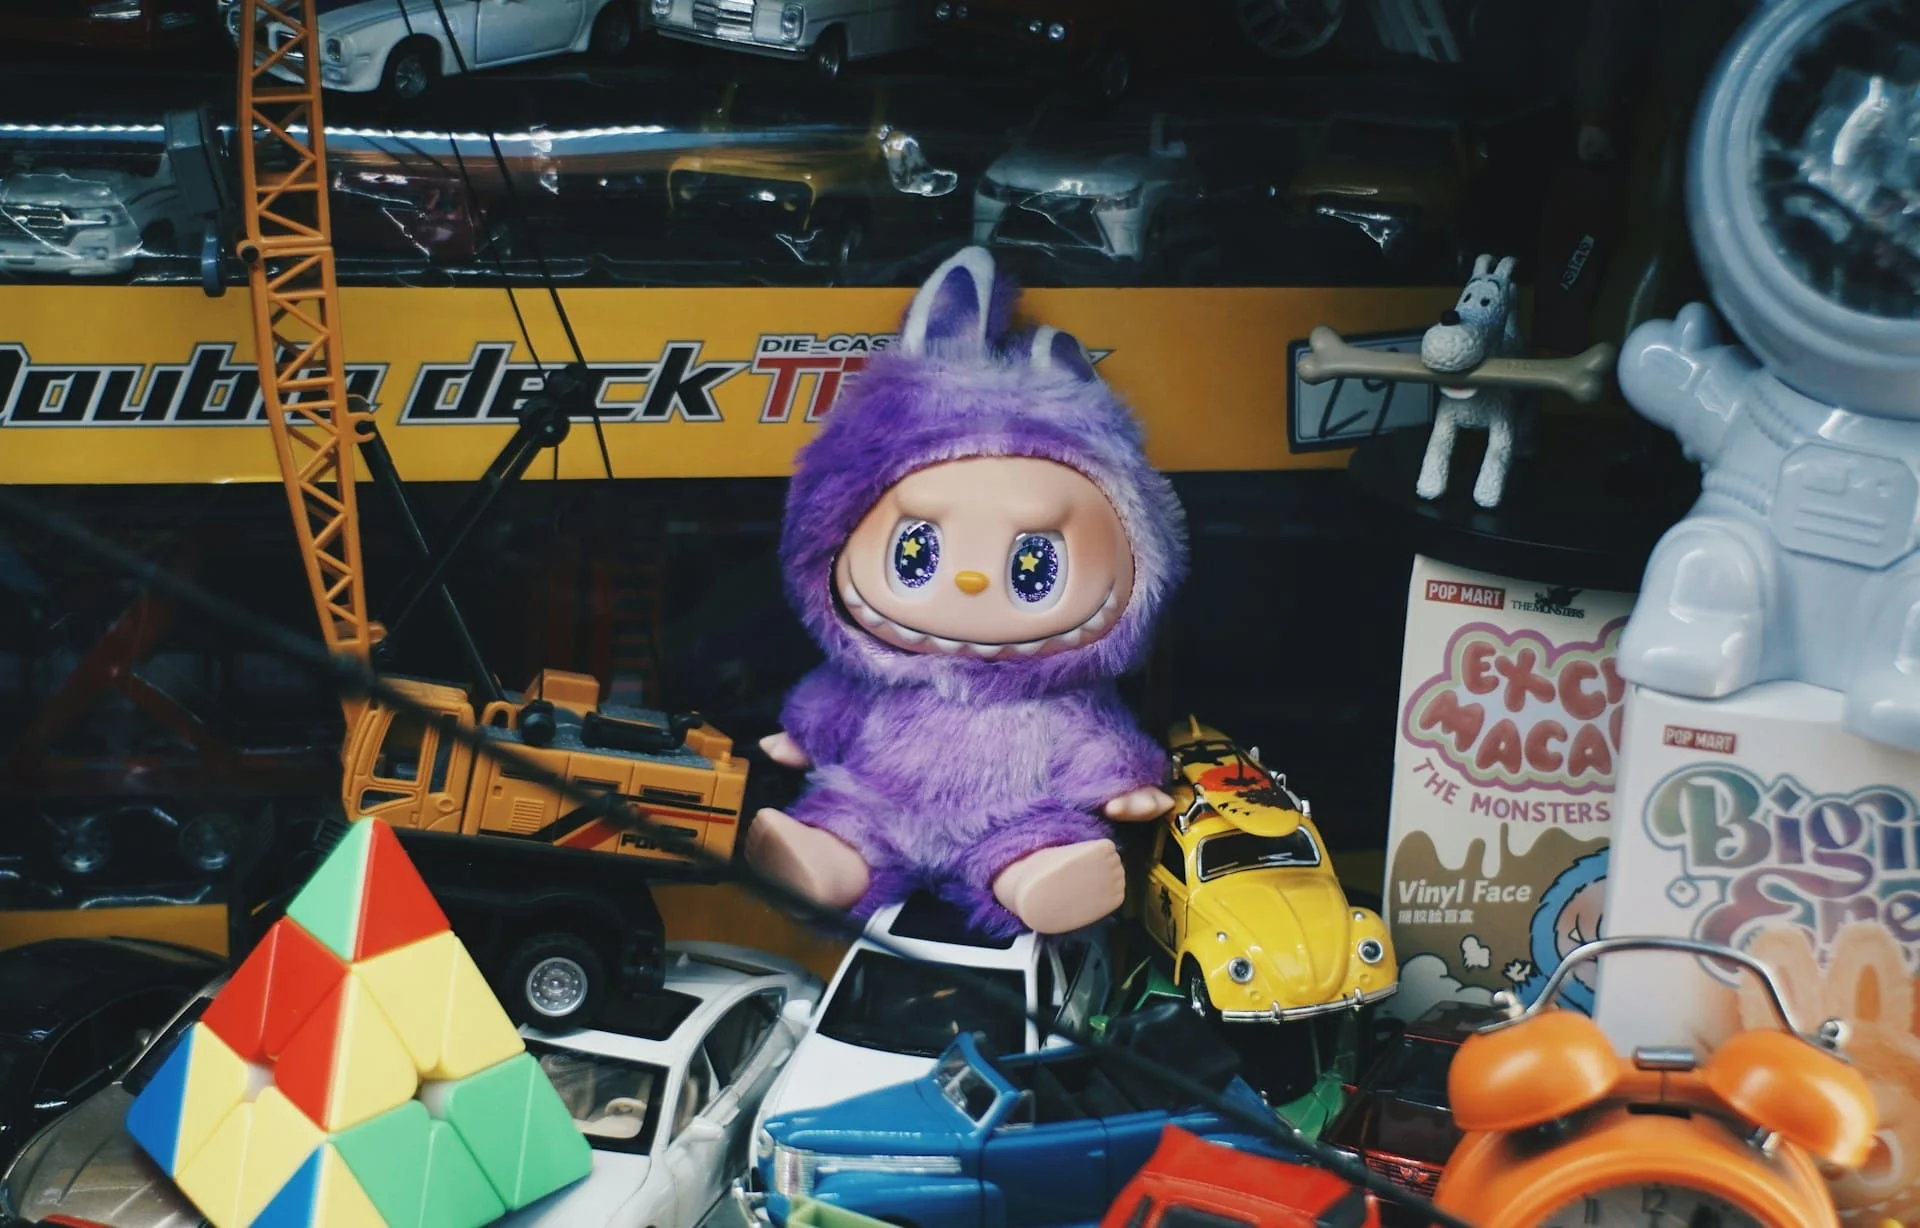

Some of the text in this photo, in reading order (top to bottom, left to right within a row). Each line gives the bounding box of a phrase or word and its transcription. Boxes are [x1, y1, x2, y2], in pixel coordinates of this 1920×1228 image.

[759, 336, 902, 353] DIE-CAS
[1428, 582, 1501, 607] POP MART
[1419, 689, 1624, 778] MACA
[1667, 727, 1733, 753] POP MART
[1413, 757, 1611, 824] THE MONSTERS
[1398, 878, 1532, 908] Vinyl Face
